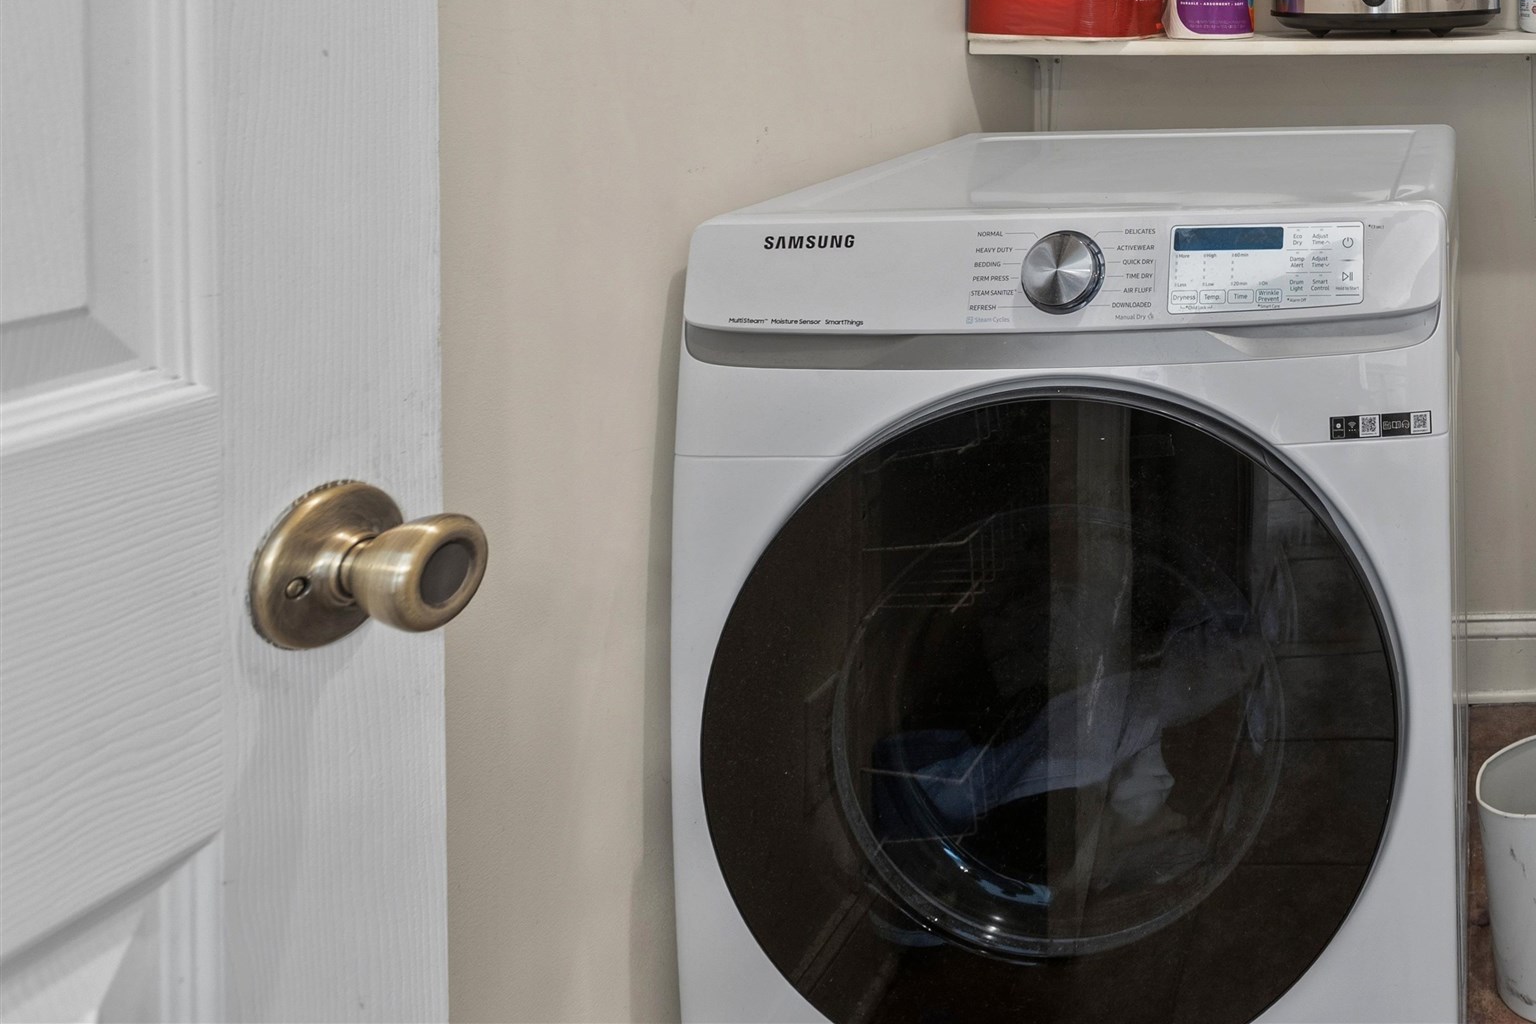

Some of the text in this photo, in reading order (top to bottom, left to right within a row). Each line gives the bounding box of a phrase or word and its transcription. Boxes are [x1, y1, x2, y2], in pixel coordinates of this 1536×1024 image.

[764, 234, 855, 250] SAMSUNG
[1204, 293, 1221, 301] Temp.
[825, 319, 864, 327] SmartThings
